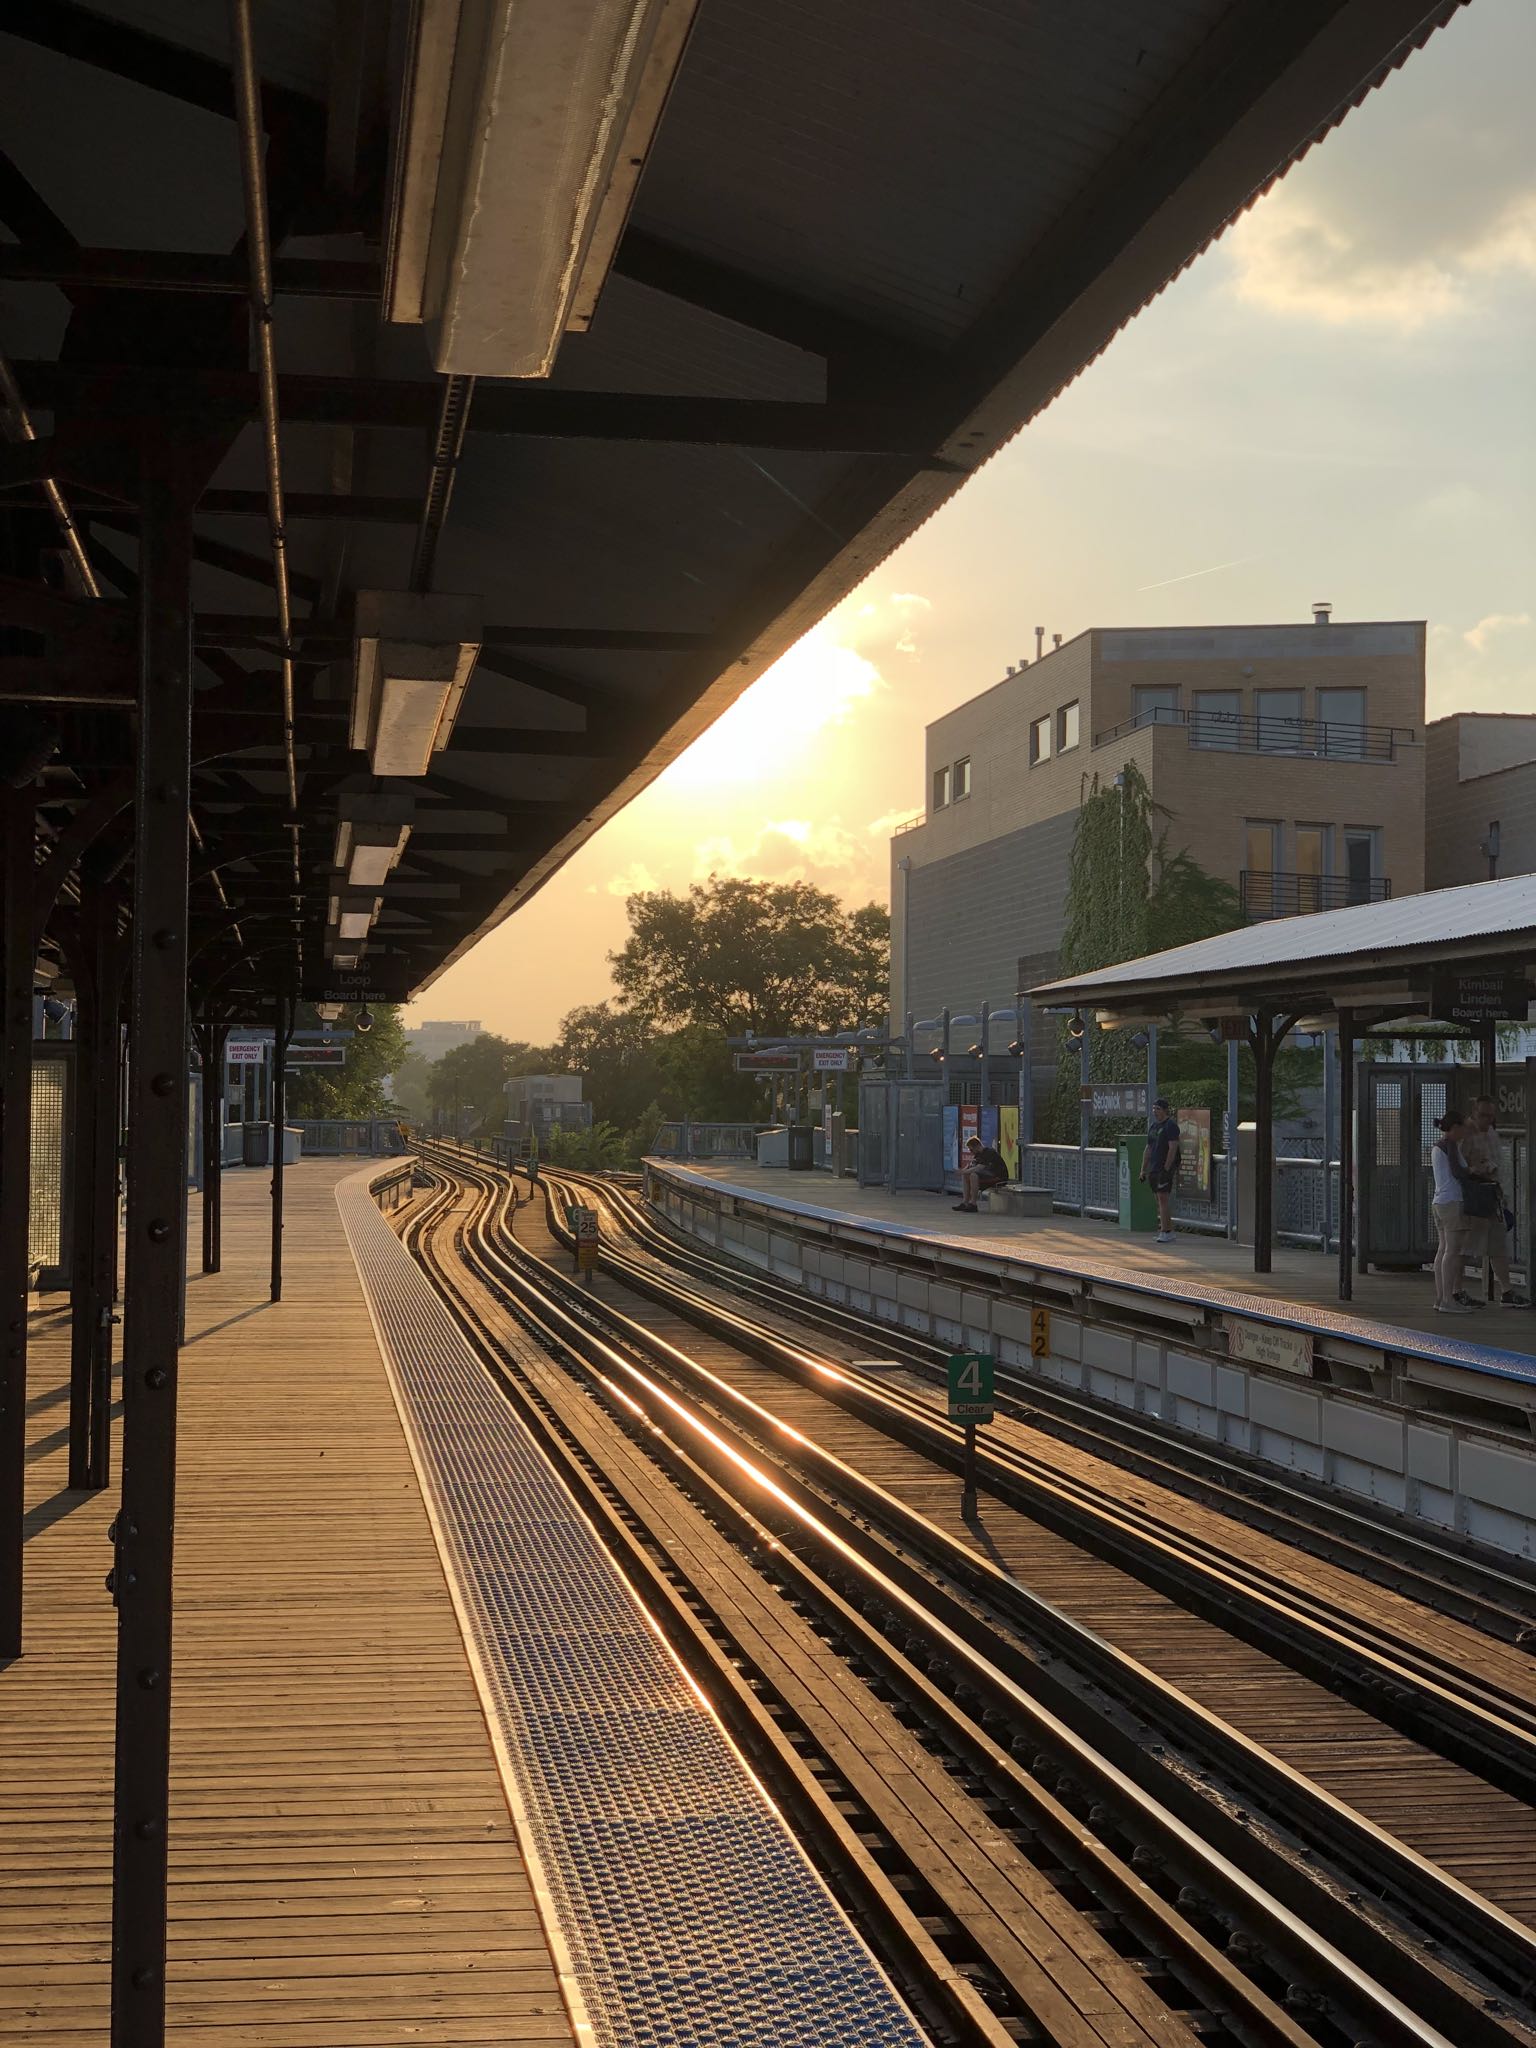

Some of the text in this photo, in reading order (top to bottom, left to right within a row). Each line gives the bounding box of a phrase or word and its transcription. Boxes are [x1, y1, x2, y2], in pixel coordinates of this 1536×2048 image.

[339, 974, 371, 987] Loop
[1458, 977, 1504, 991] Kimball
[323, 989, 386, 1000] Board here
[1459, 993, 1502, 1005] Linden
[1452, 1007, 1509, 1018] Board here
[1093, 1091, 1120, 1114] Sedgwick
[580, 1222, 596, 1233] 25
[1034, 1311, 1046, 1331] 4
[1034, 1336, 1046, 1356] 2
[957, 1360, 983, 1396] 4
[957, 1404, 985, 1414] Clear
